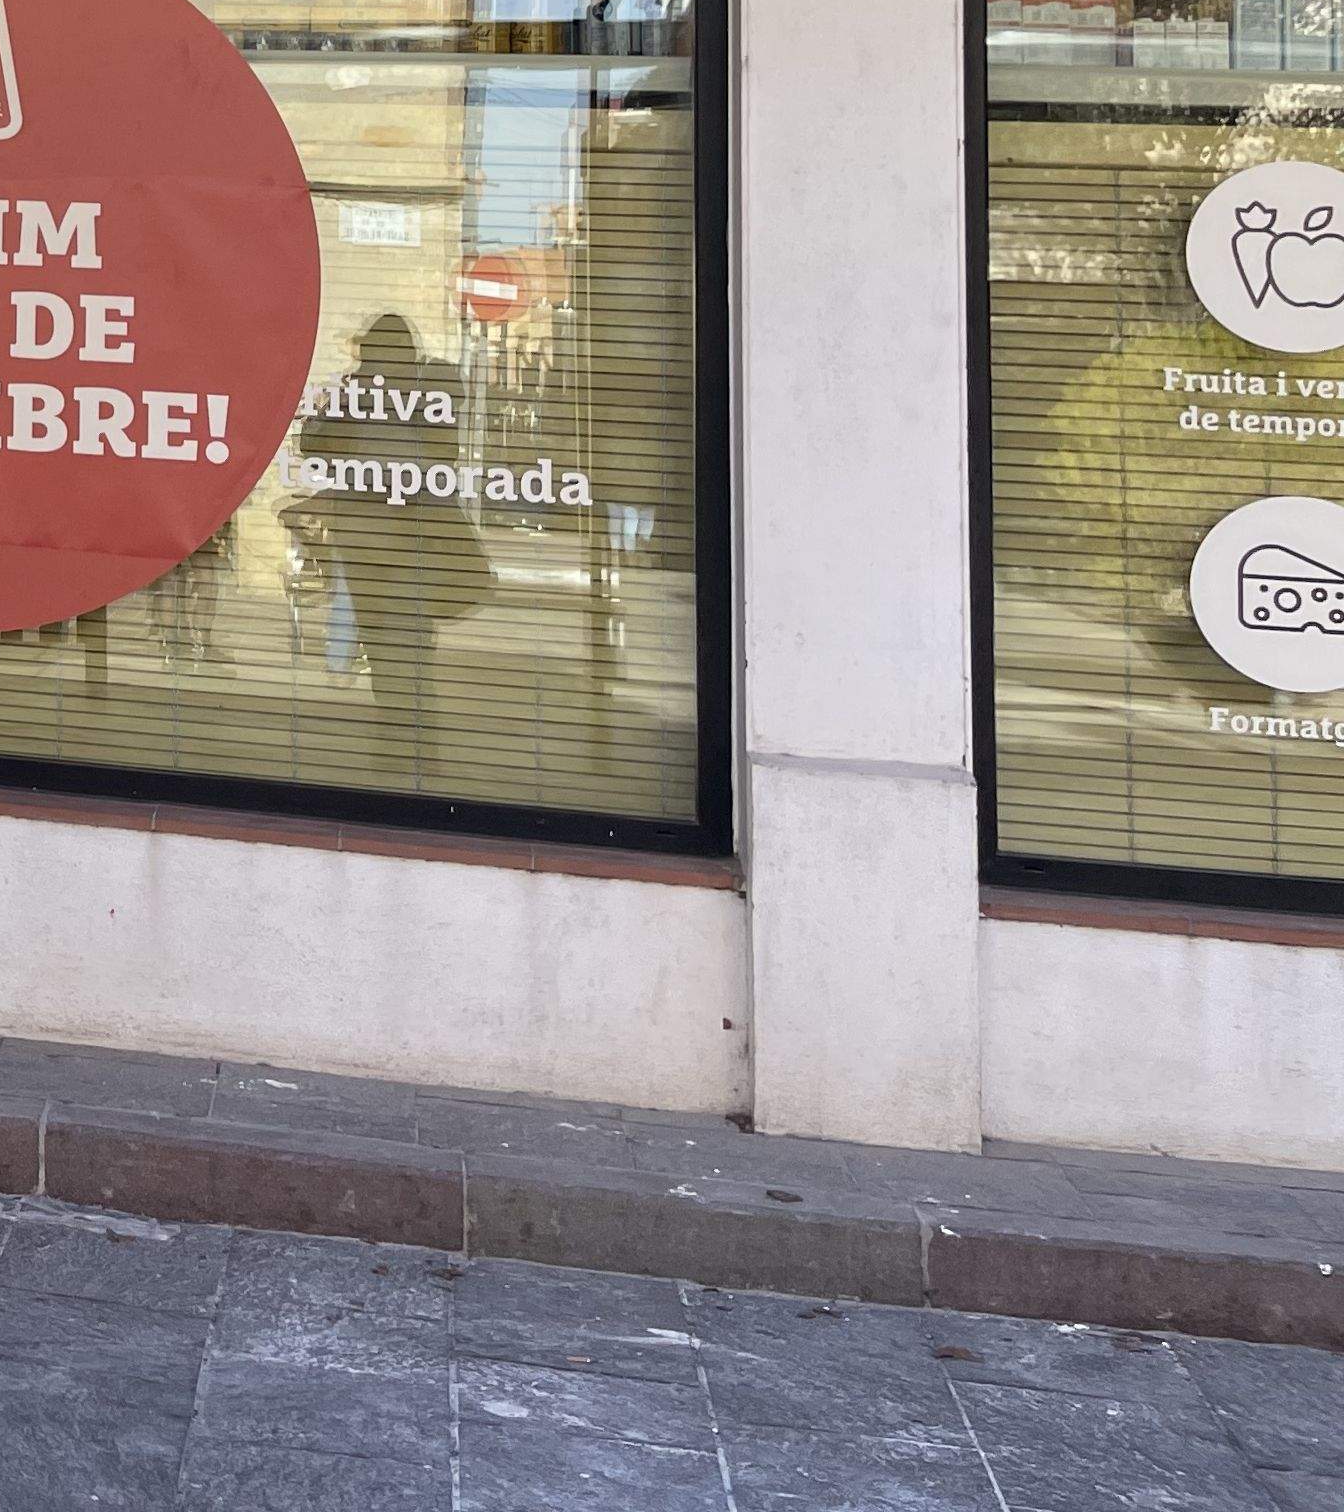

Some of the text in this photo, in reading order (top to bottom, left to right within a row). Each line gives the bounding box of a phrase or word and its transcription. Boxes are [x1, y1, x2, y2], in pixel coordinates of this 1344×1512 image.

[10, 291, 135, 364] DE
[1163, 366, 1268, 396] Fruita
[1276, 371, 1288, 397] i
[1179, 405, 1220, 432] de
[277, 450, 593, 507] temporada
